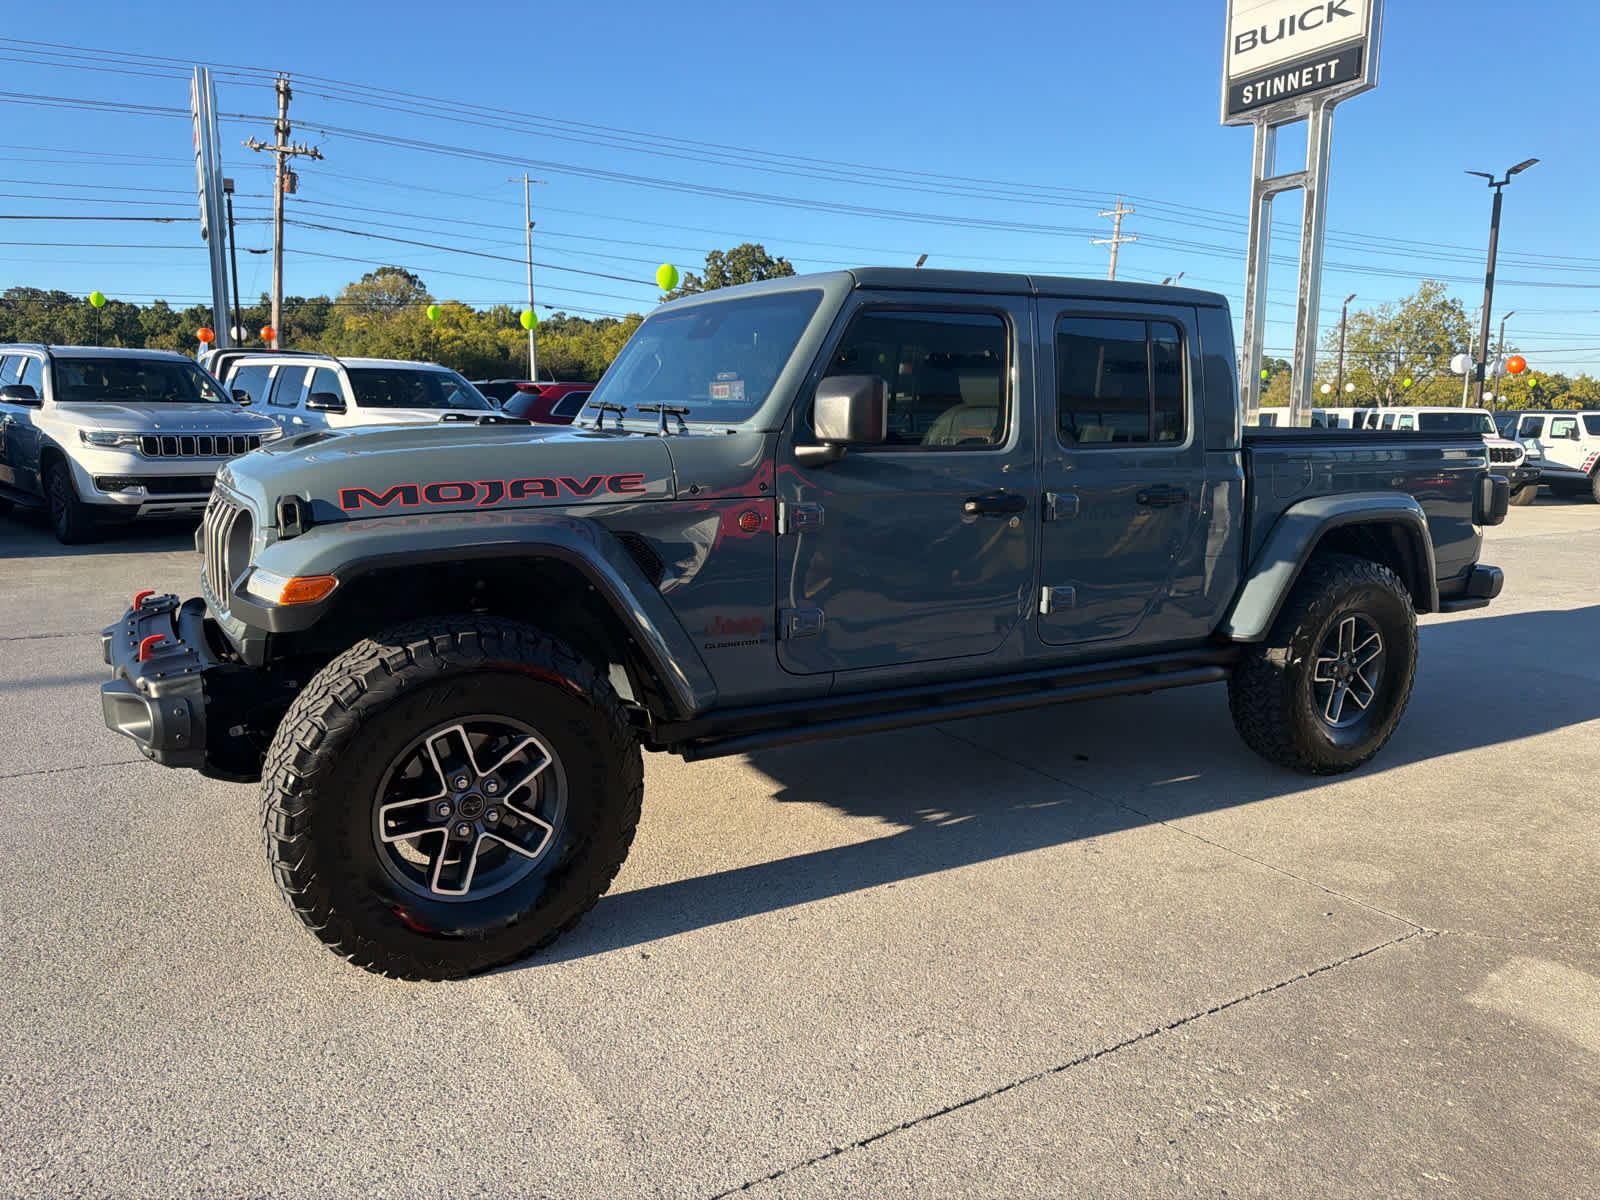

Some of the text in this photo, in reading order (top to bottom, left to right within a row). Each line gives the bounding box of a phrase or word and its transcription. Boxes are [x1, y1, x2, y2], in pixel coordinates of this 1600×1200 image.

[1235, 0, 1355, 55] BUICK
[1242, 59, 1340, 104] STINNETT
[339, 474, 647, 510] MOJAVE
